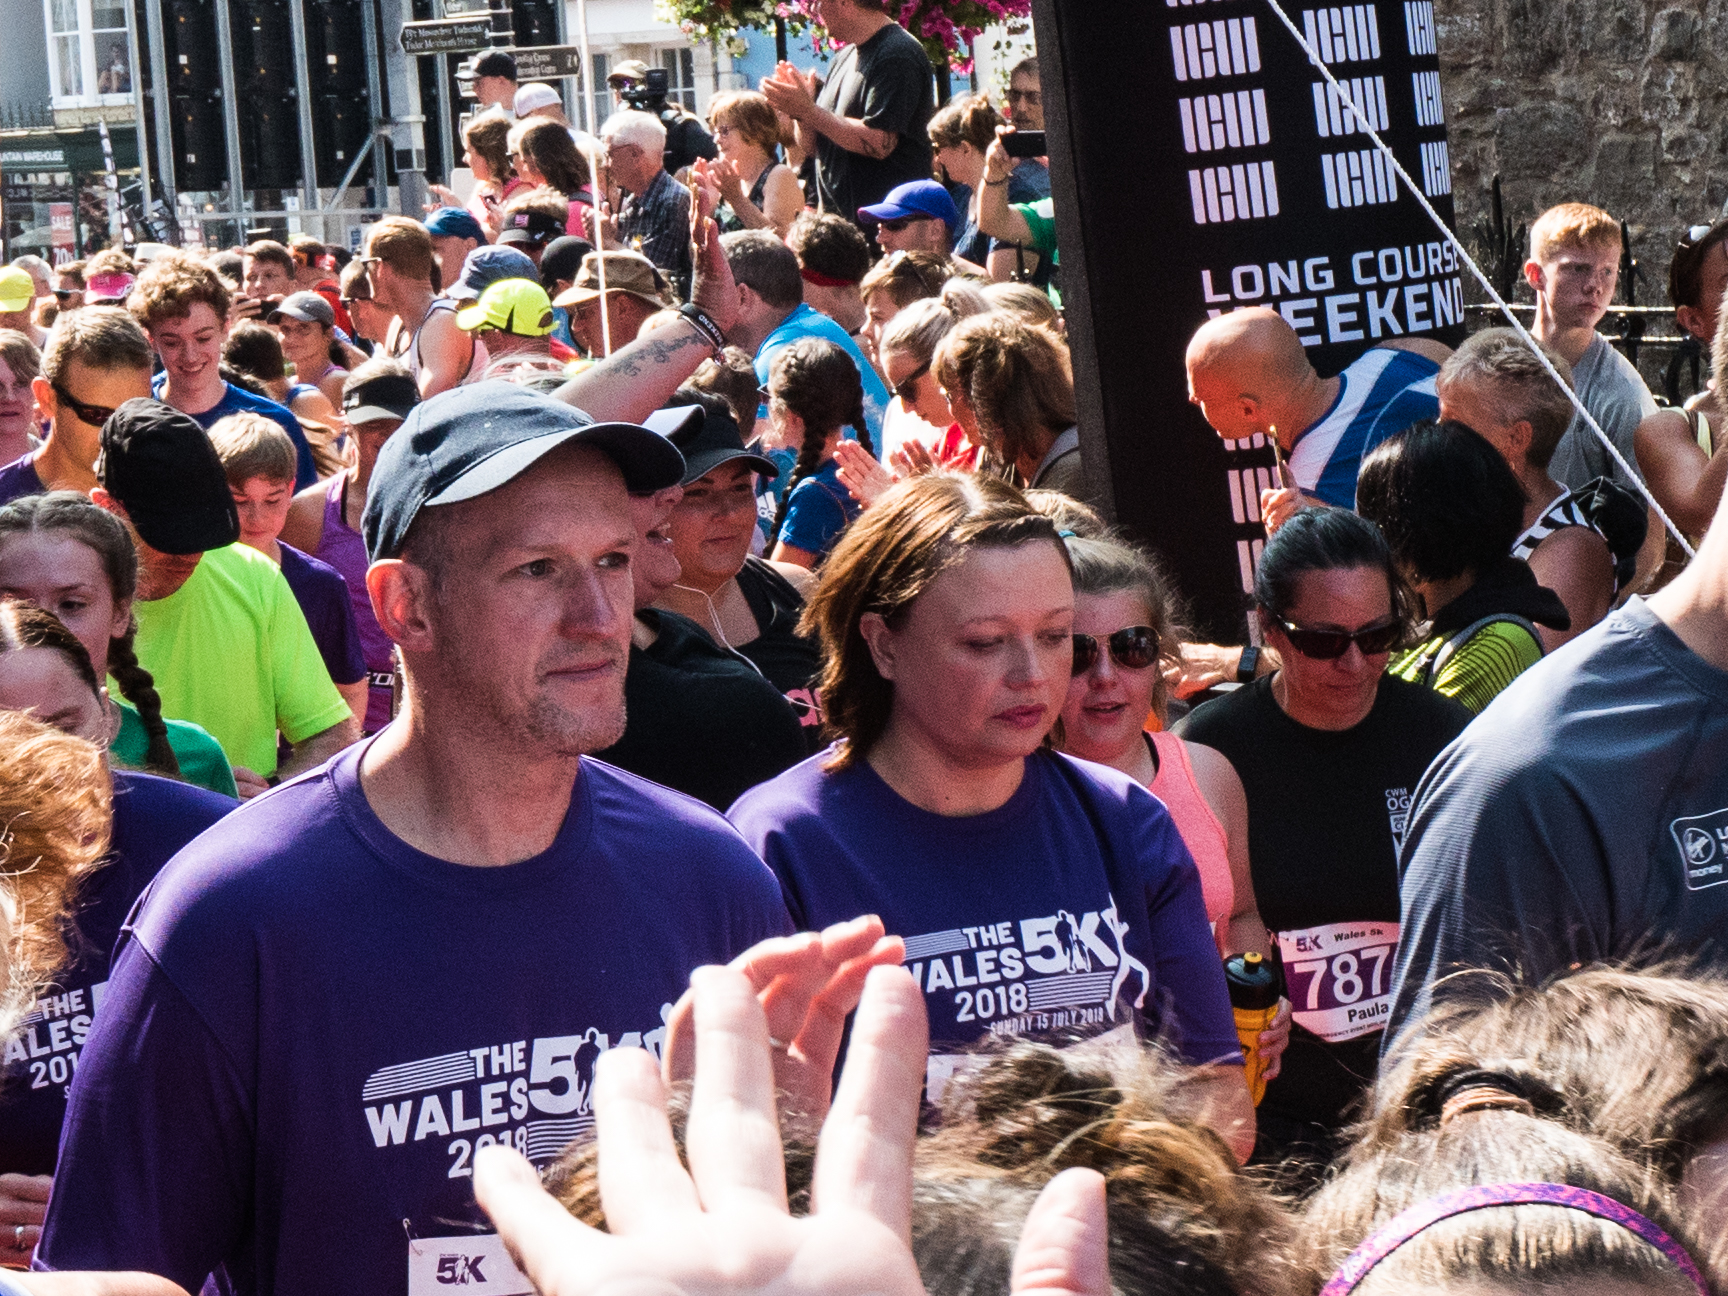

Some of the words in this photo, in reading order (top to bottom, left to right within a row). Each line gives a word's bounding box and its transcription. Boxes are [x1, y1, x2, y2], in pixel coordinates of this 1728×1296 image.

[1201, 256, 1335, 303] LONG
[1351, 239, 1459, 286] COURSE
[1206, 276, 1465, 347] EEKEND
[1385, 787, 1407, 797] CWM
[962, 921, 1015, 949] THE
[1019, 910, 1119, 974] 5K
[1333, 931, 1366, 942] Wales
[1369, 928, 1384, 937] 5k
[37, 989, 85, 1020] THE
[955, 982, 1028, 1023] 2018
[1347, 1003, 1389, 1023] Paula
[1037, 1015, 1048, 1030] 15
[1080, 1007, 1104, 1025] 2018
[470, 1041, 527, 1078] THE
[364, 1078, 529, 1148] WALES
[436, 1255, 488, 1285] 5K
